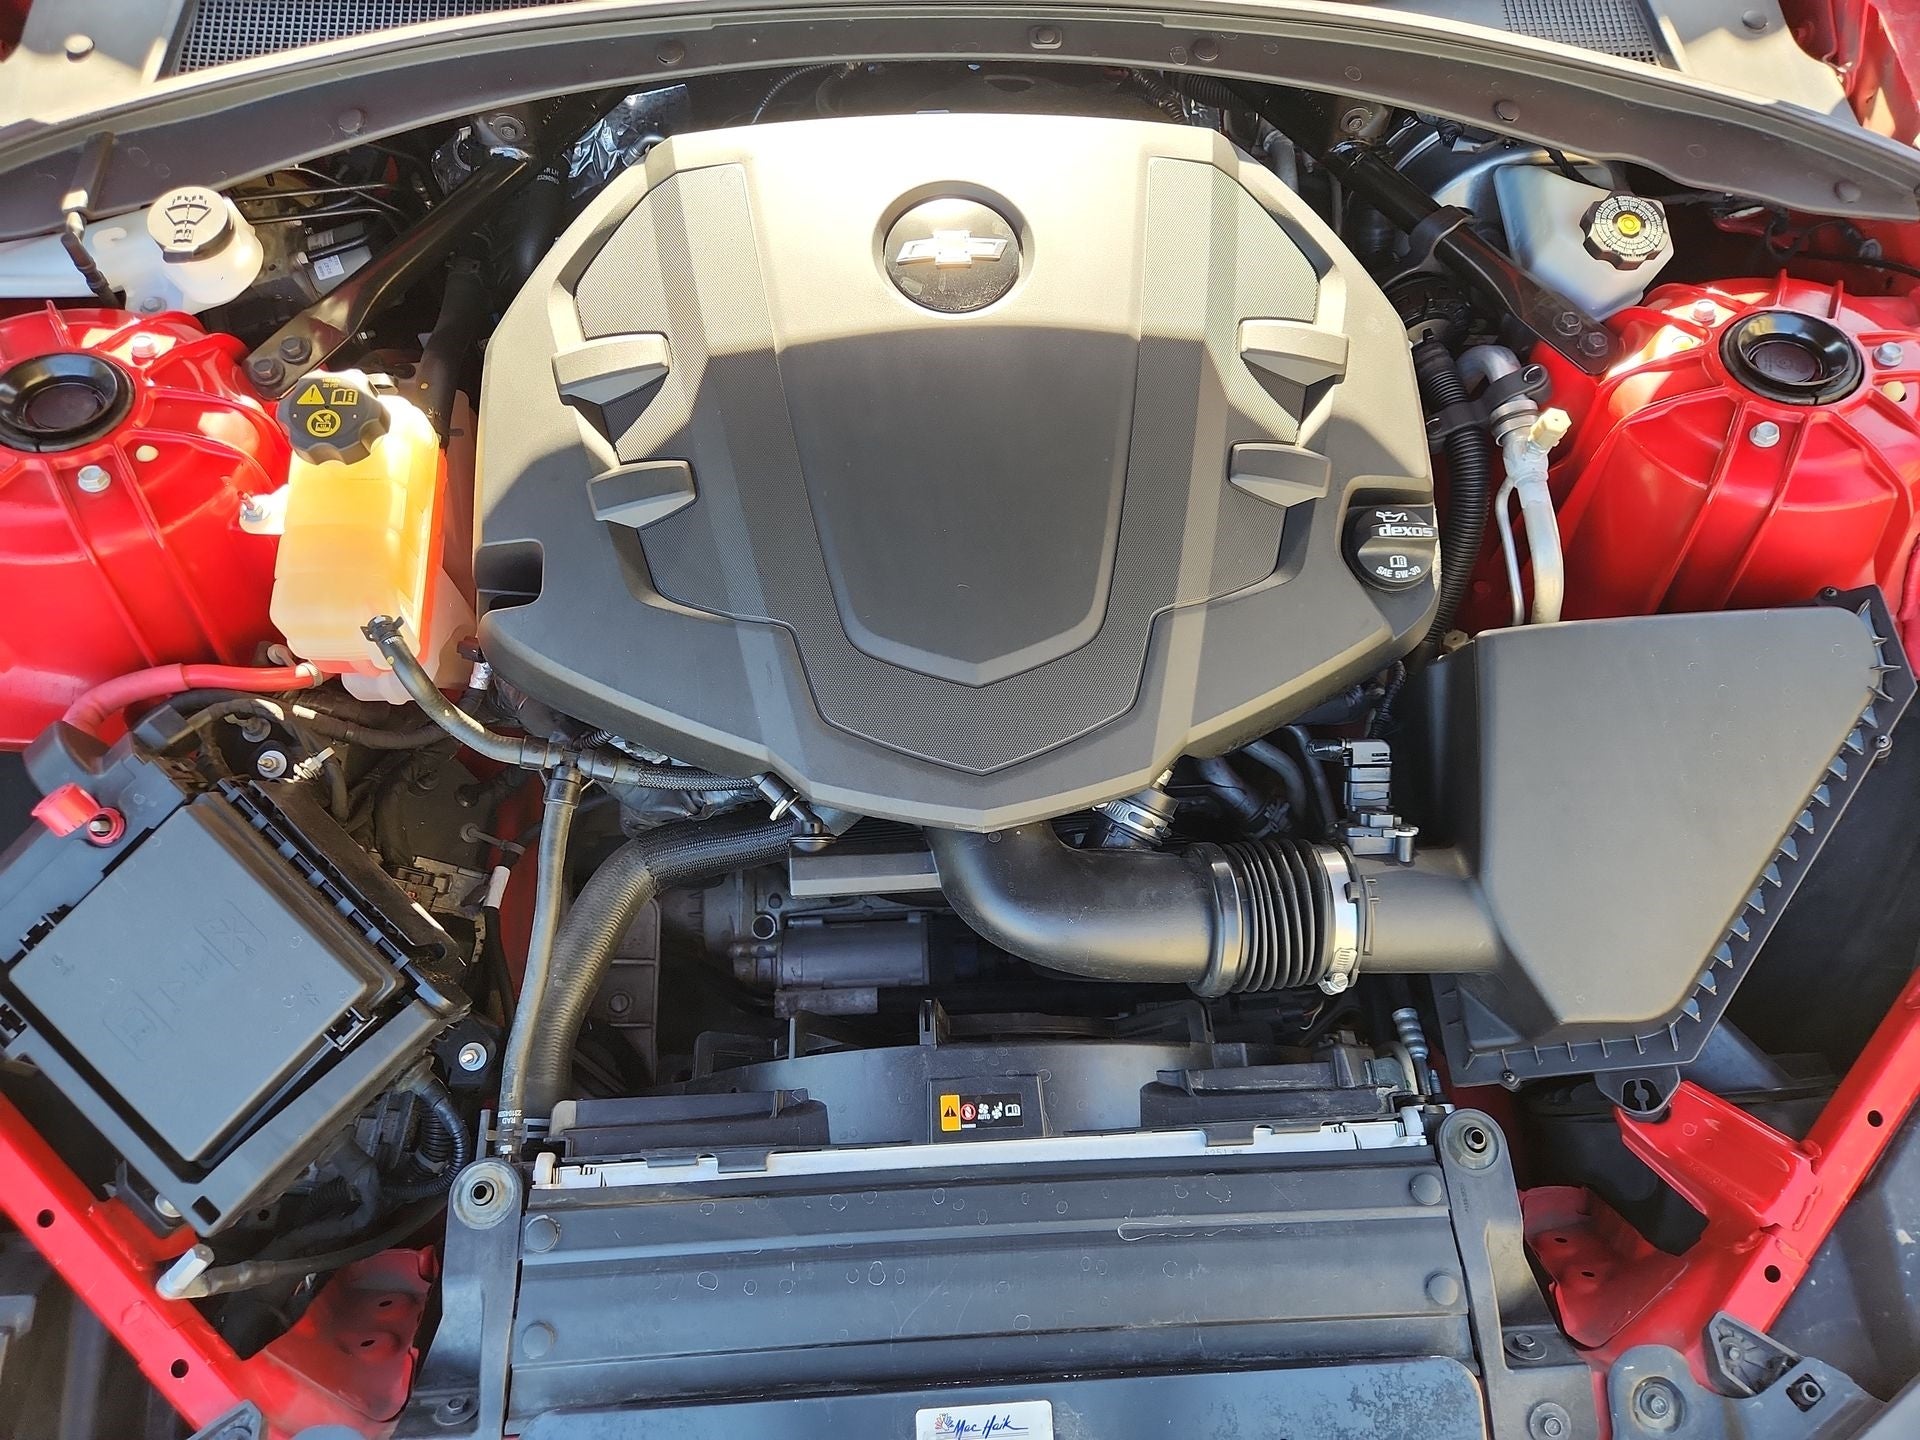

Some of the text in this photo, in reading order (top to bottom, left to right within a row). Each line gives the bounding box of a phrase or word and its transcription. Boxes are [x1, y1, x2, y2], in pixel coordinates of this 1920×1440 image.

[1378, 523, 1434, 537] dexos
[1376, 565, 1421, 579] SAE 5W-30
[953, 1414, 1027, 1440] Mac Haik
